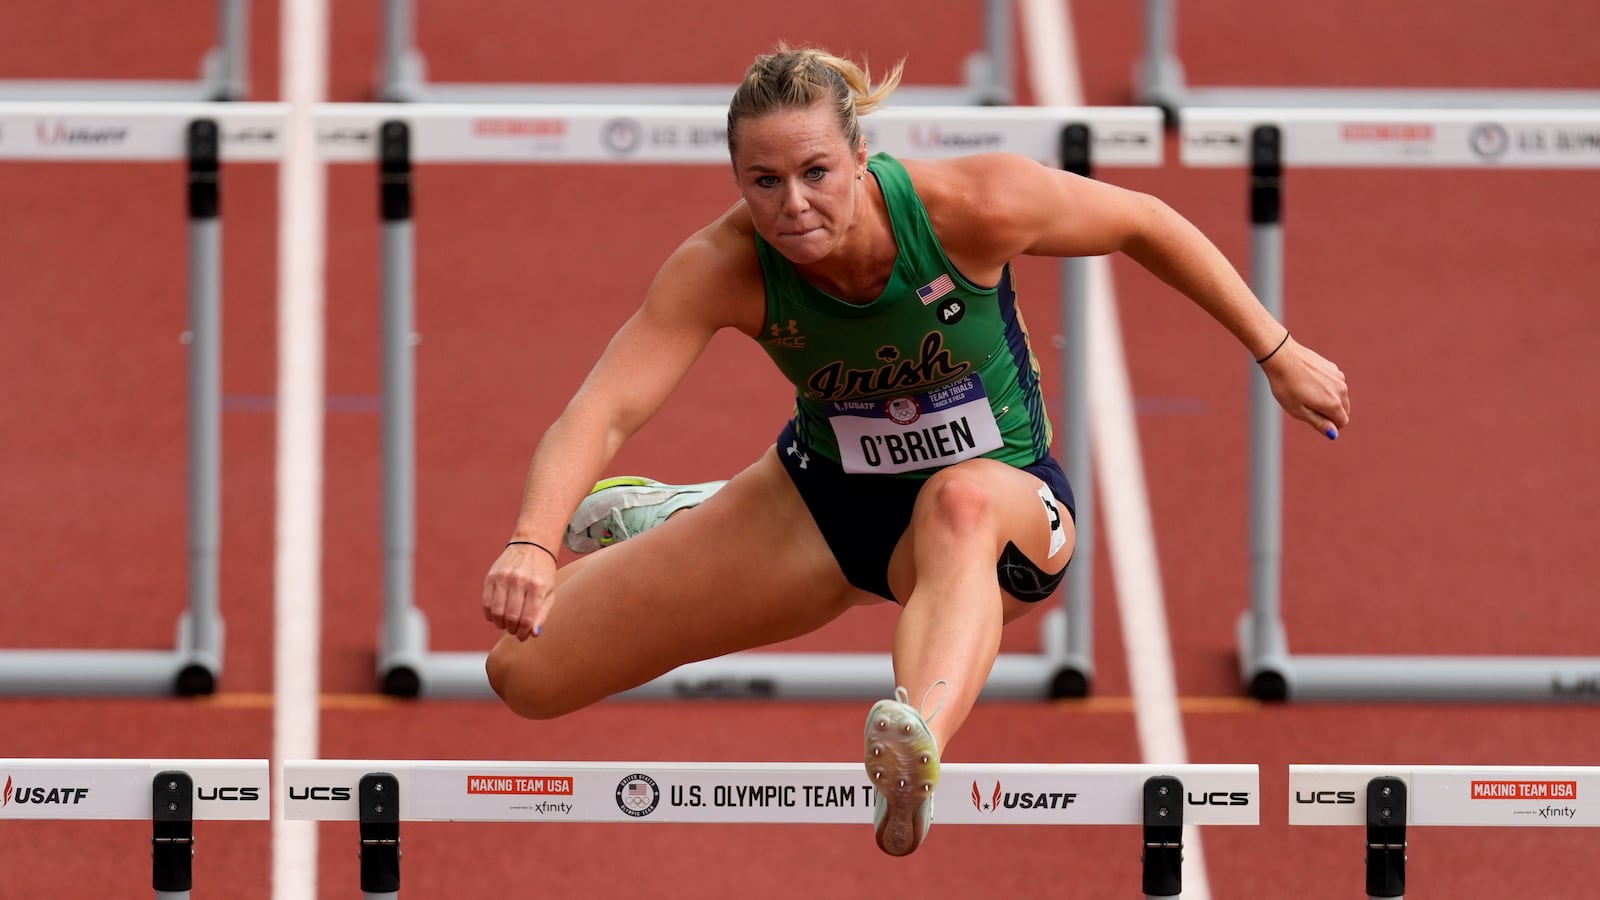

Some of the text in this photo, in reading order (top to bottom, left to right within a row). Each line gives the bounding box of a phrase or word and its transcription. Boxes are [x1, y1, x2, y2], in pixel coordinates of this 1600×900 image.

[943, 302, 961, 321] AB
[808, 330, 971, 401] Irish
[929, 390, 949, 402] TEAM
[949, 381, 974, 397] TRIALS
[860, 416, 976, 467] O'BRIEN
[470, 778, 570, 793] MAKING TEAM USA
[1474, 783, 1573, 797] MAKING TEAM USA
[14, 788, 89, 804] USATF
[197, 787, 259, 800] UCS
[289, 787, 351, 800] UCS
[671, 785, 706, 807] U.S.
[714, 785, 795, 807] OLYMPIC
[803, 785, 855, 808] TEAM
[1003, 792, 1077, 809] USATF
[1188, 792, 1250, 806] UCS
[1296, 791, 1355, 804] UCS
[535, 801, 573, 814] xfinity
[1539, 805, 1577, 818] xfinity
